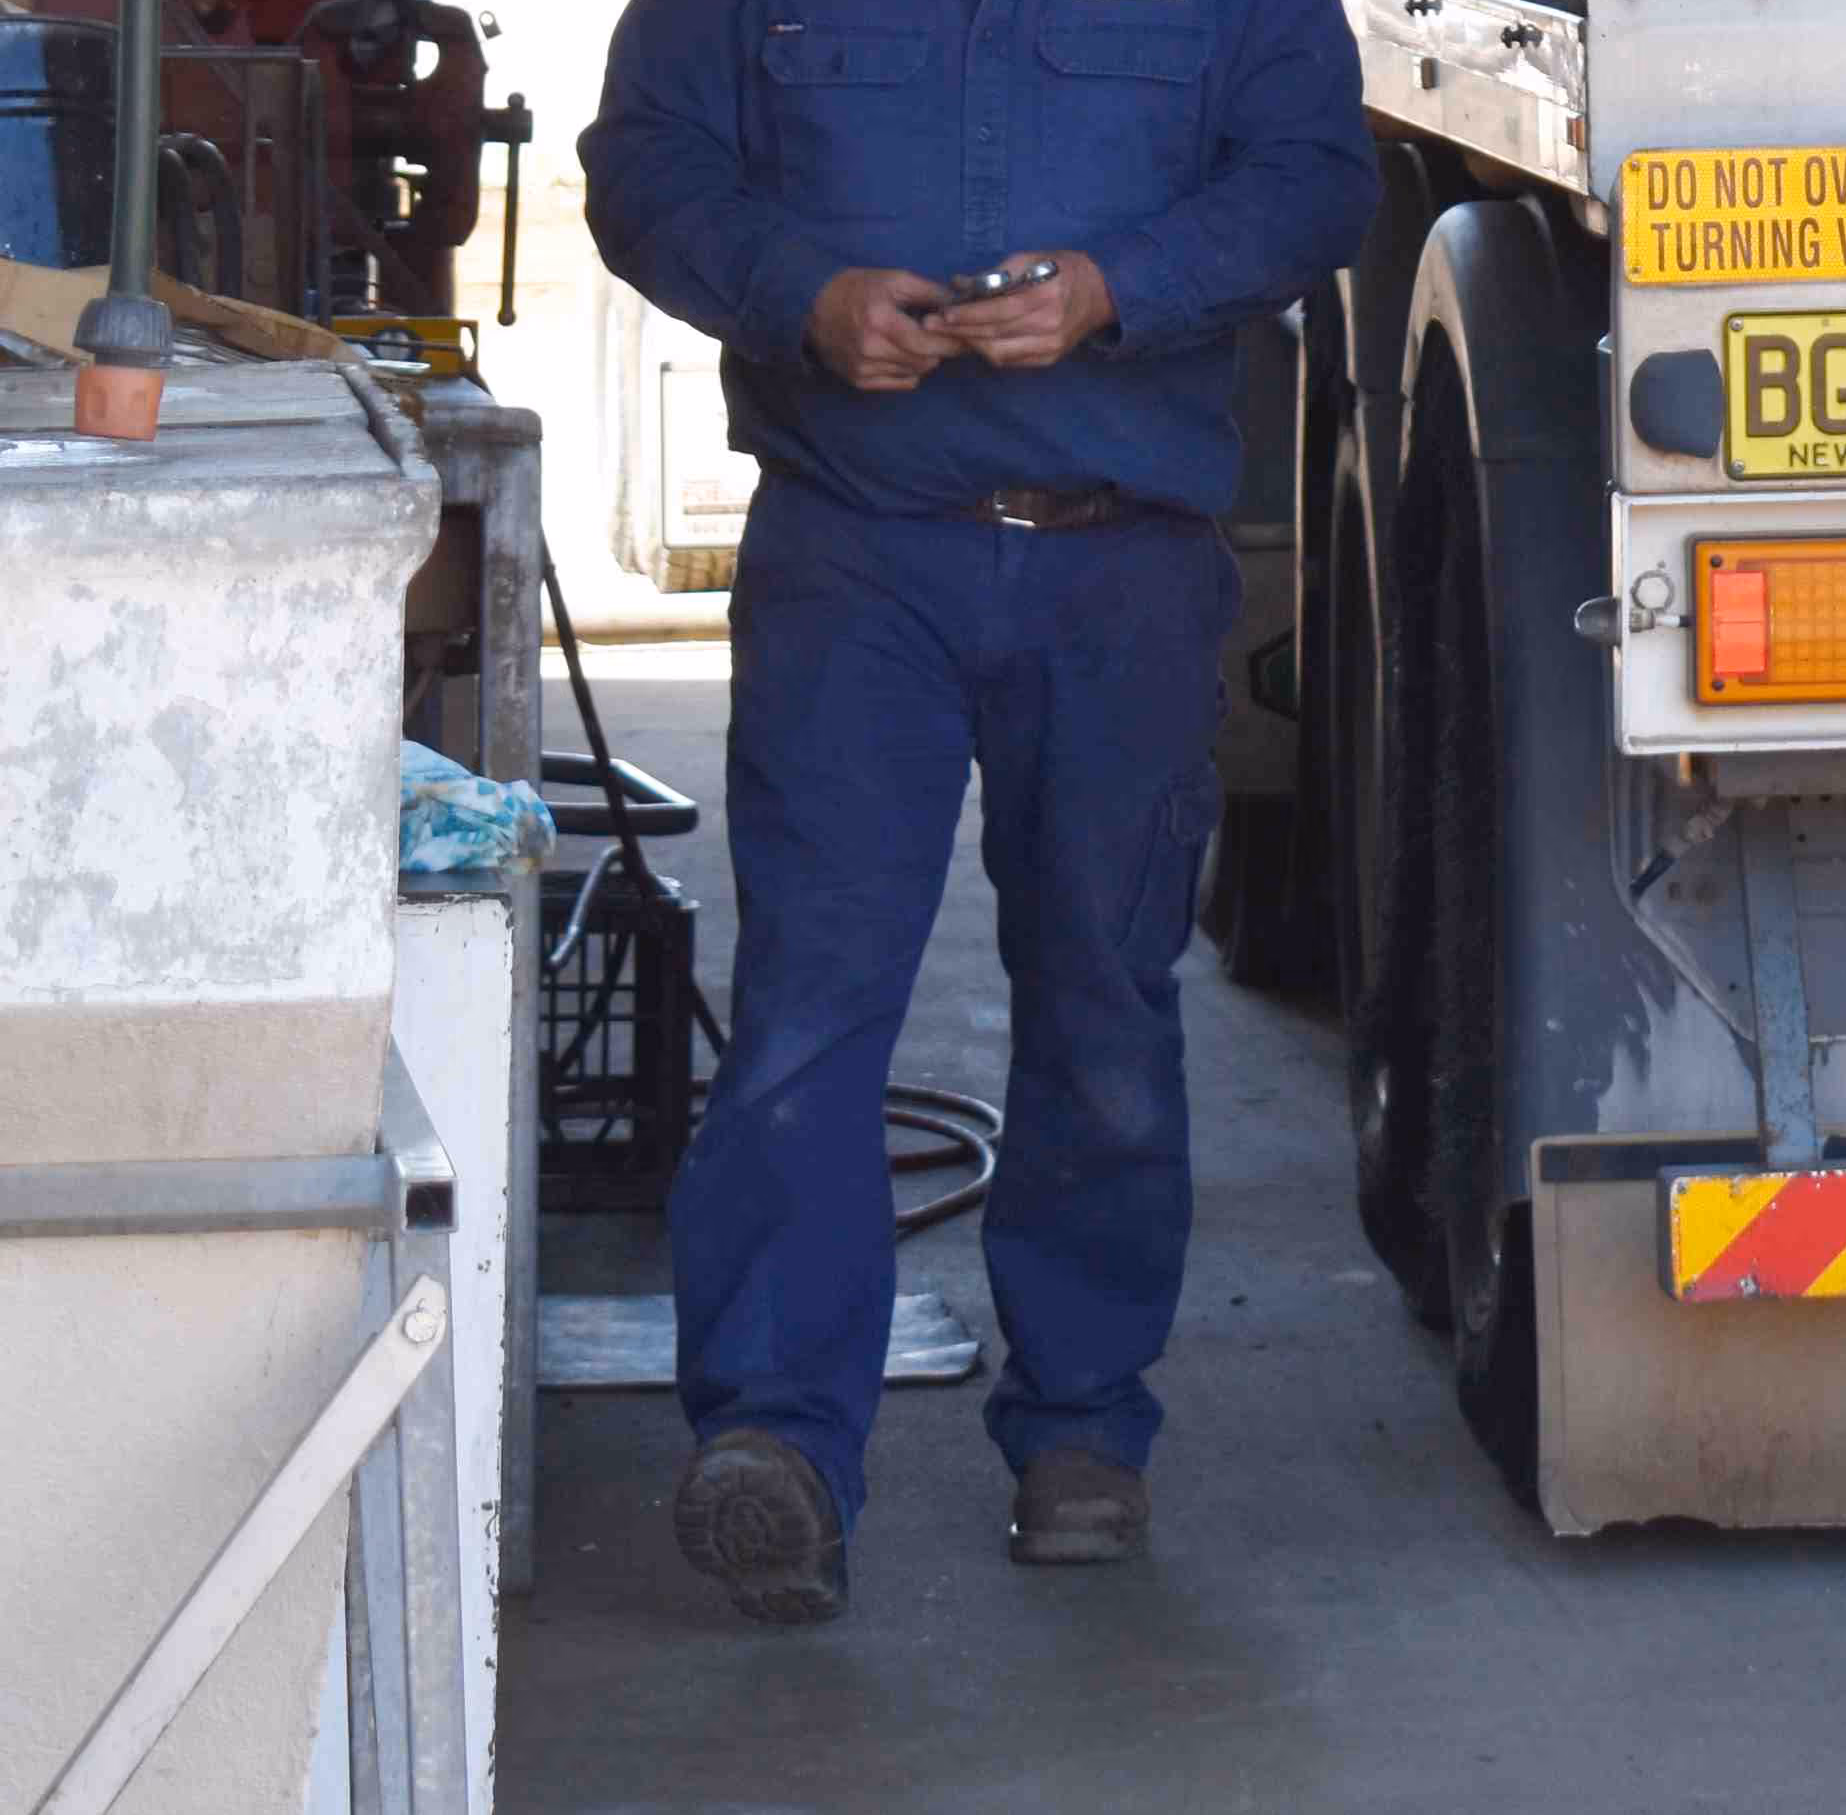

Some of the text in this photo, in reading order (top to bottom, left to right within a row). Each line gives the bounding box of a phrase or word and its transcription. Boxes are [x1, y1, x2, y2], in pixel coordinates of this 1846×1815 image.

[1648, 159, 1698, 212] DO
[1715, 156, 1788, 209] NOT
[1651, 220, 1821, 272] TURNING
